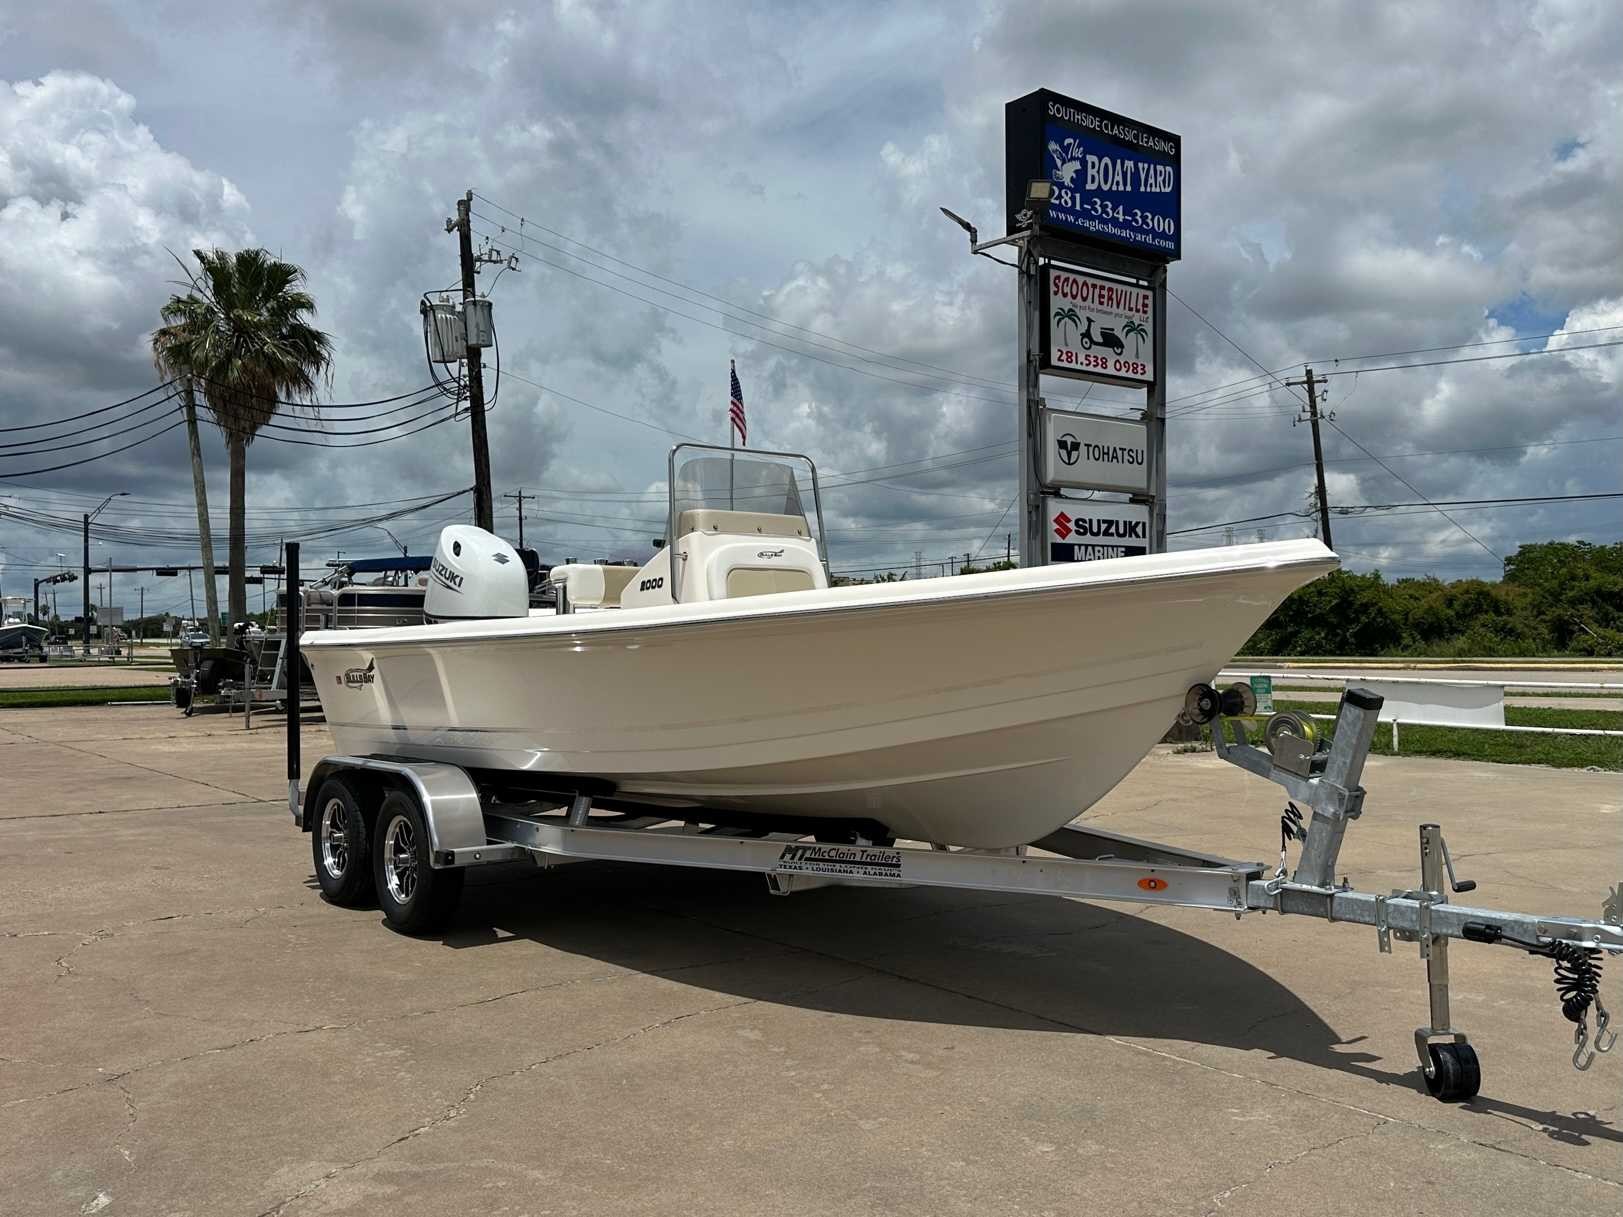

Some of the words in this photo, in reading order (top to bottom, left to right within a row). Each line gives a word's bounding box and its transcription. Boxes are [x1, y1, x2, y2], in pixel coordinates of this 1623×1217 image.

[1048, 101, 1100, 130] SOUTHSIDE
[1102, 120, 1137, 143] CLASSIC
[1138, 133, 1175, 154] LEASING
[1064, 138, 1084, 159] The
[1085, 154, 1134, 191] BOAT
[1138, 161, 1174, 192] YARD
[1050, 186, 1174, 235] 281-334-3300
[1049, 208, 1174, 249] www.eaglesboatyard.com
[1053, 274, 1149, 315] SCOOTERVILLE
[1114, 359, 1147, 376] 0983
[1084, 443, 1144, 466] TOHATSU
[1074, 517, 1146, 539] SUZUKI
[810, 846, 856, 860] McClain
[779, 863, 802, 871] TEXAS
[812, 865, 853, 874] LOUISIANA
[863, 870, 901, 878] ALABAMA
